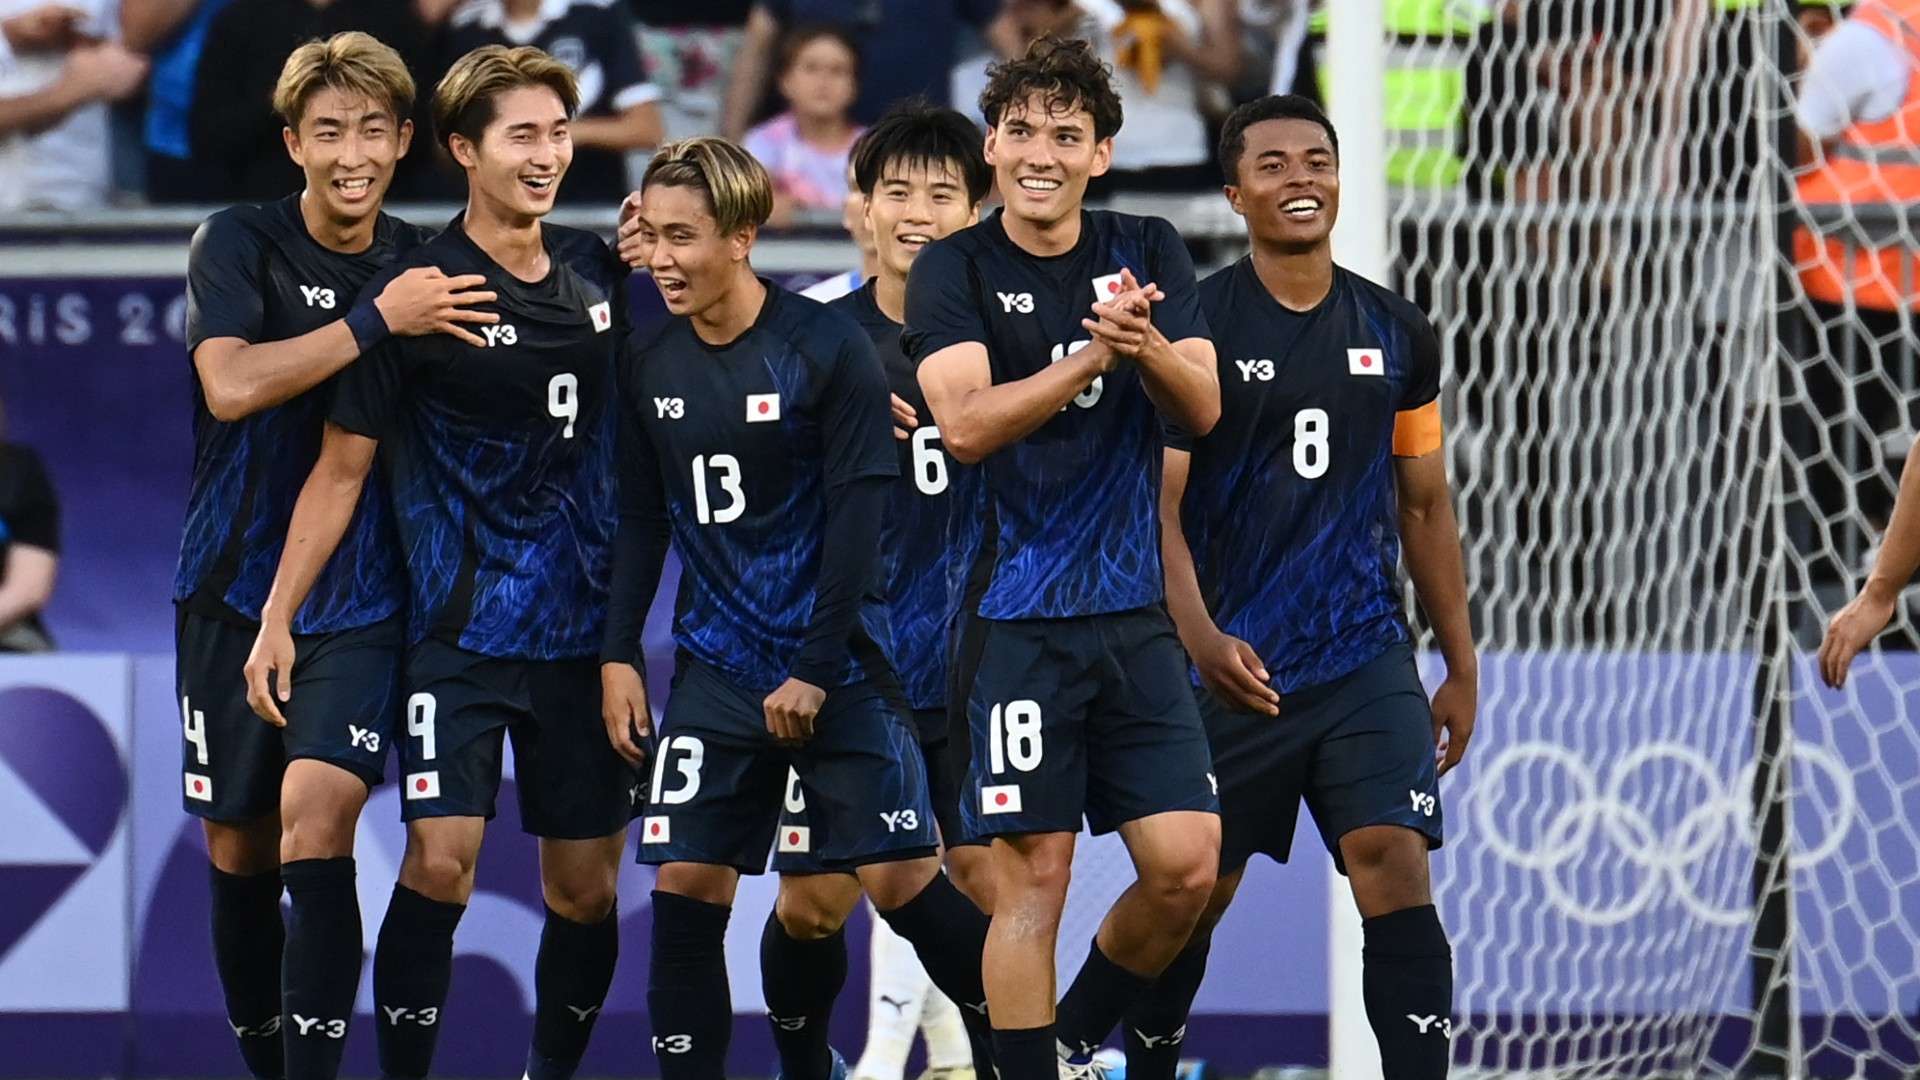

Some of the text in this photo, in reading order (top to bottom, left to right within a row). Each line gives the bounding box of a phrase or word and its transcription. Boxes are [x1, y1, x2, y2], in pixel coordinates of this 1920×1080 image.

[300, 285, 336, 310] Y-3
[997, 291, 1035, 314] Y-3
[480, 324, 518, 347] Y-3
[1235, 359, 1275, 382] Y-3
[548, 372, 578, 438] 9
[653, 396, 685, 420] Y-3
[1292, 408, 1331, 479] 8
[912, 426, 949, 495] 6
[692, 454, 746, 525] 13
[182, 695, 209, 766] 4
[348, 724, 381, 753] Y-3
[406, 692, 437, 760] 9
[989, 699, 1043, 775] 18
[650, 735, 705, 805] 13
[1409, 789, 1436, 817] Y-3
[879, 809, 919, 833] Y-3
[291, 1013, 347, 1039] Y-3
[383, 1004, 438, 1026] Y-3
[1405, 1013, 1452, 1040] Y-3
